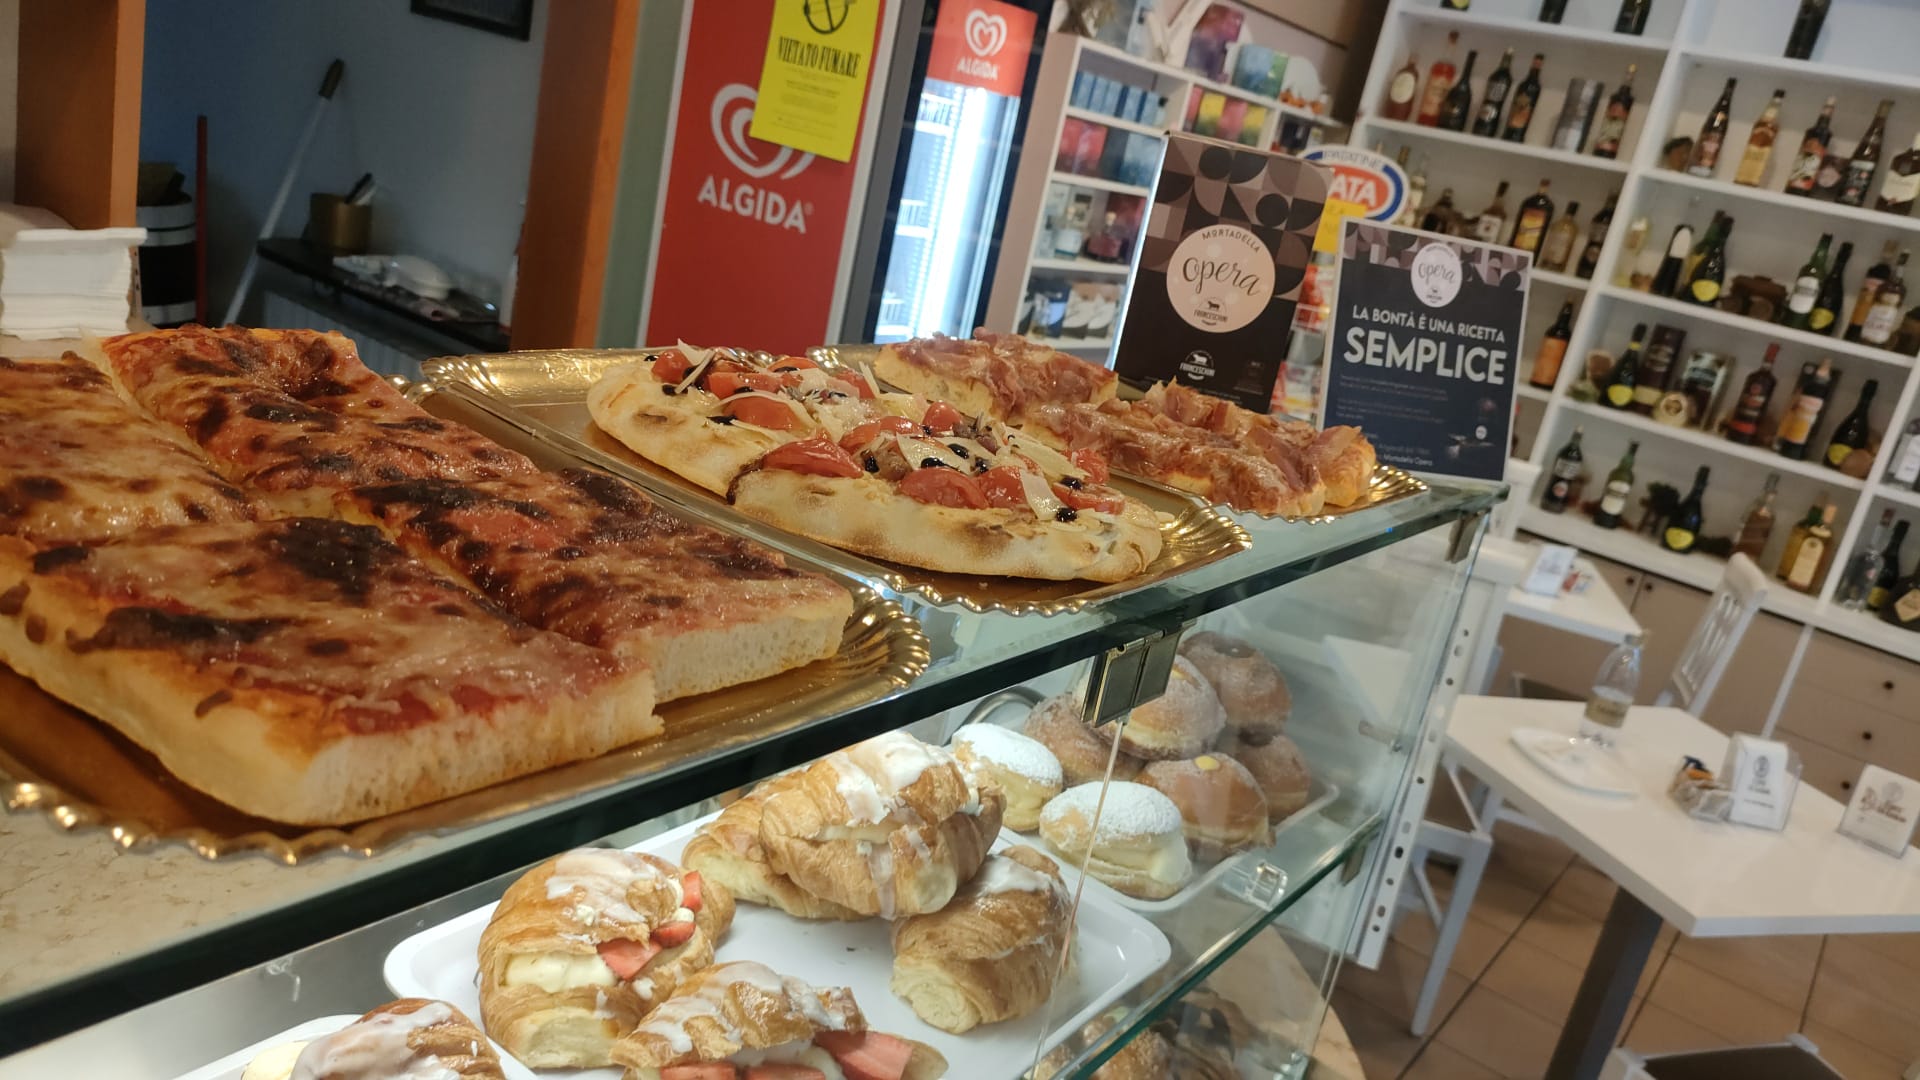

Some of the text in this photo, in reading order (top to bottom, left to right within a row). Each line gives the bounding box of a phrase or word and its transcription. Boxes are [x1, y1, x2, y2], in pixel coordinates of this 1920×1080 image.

[778, 36, 819, 68] VIETATO
[818, 45, 862, 79] FUMARE
[956, 56, 998, 81] ALGIDA
[697, 174, 807, 235] ALGIDA
[1327, 173, 1377, 208] ATA
[1202, 228, 1260, 253] MORTADELLA
[1183, 257, 1261, 296] opera
[1418, 262, 1456, 285] opera
[1352, 304, 1369, 321] LA
[1372, 308, 1416, 329] BONTÀ
[1429, 318, 1455, 335] UNA
[1457, 323, 1505, 343] RICETTA
[1343, 326, 1508, 385] SEMPLICE
